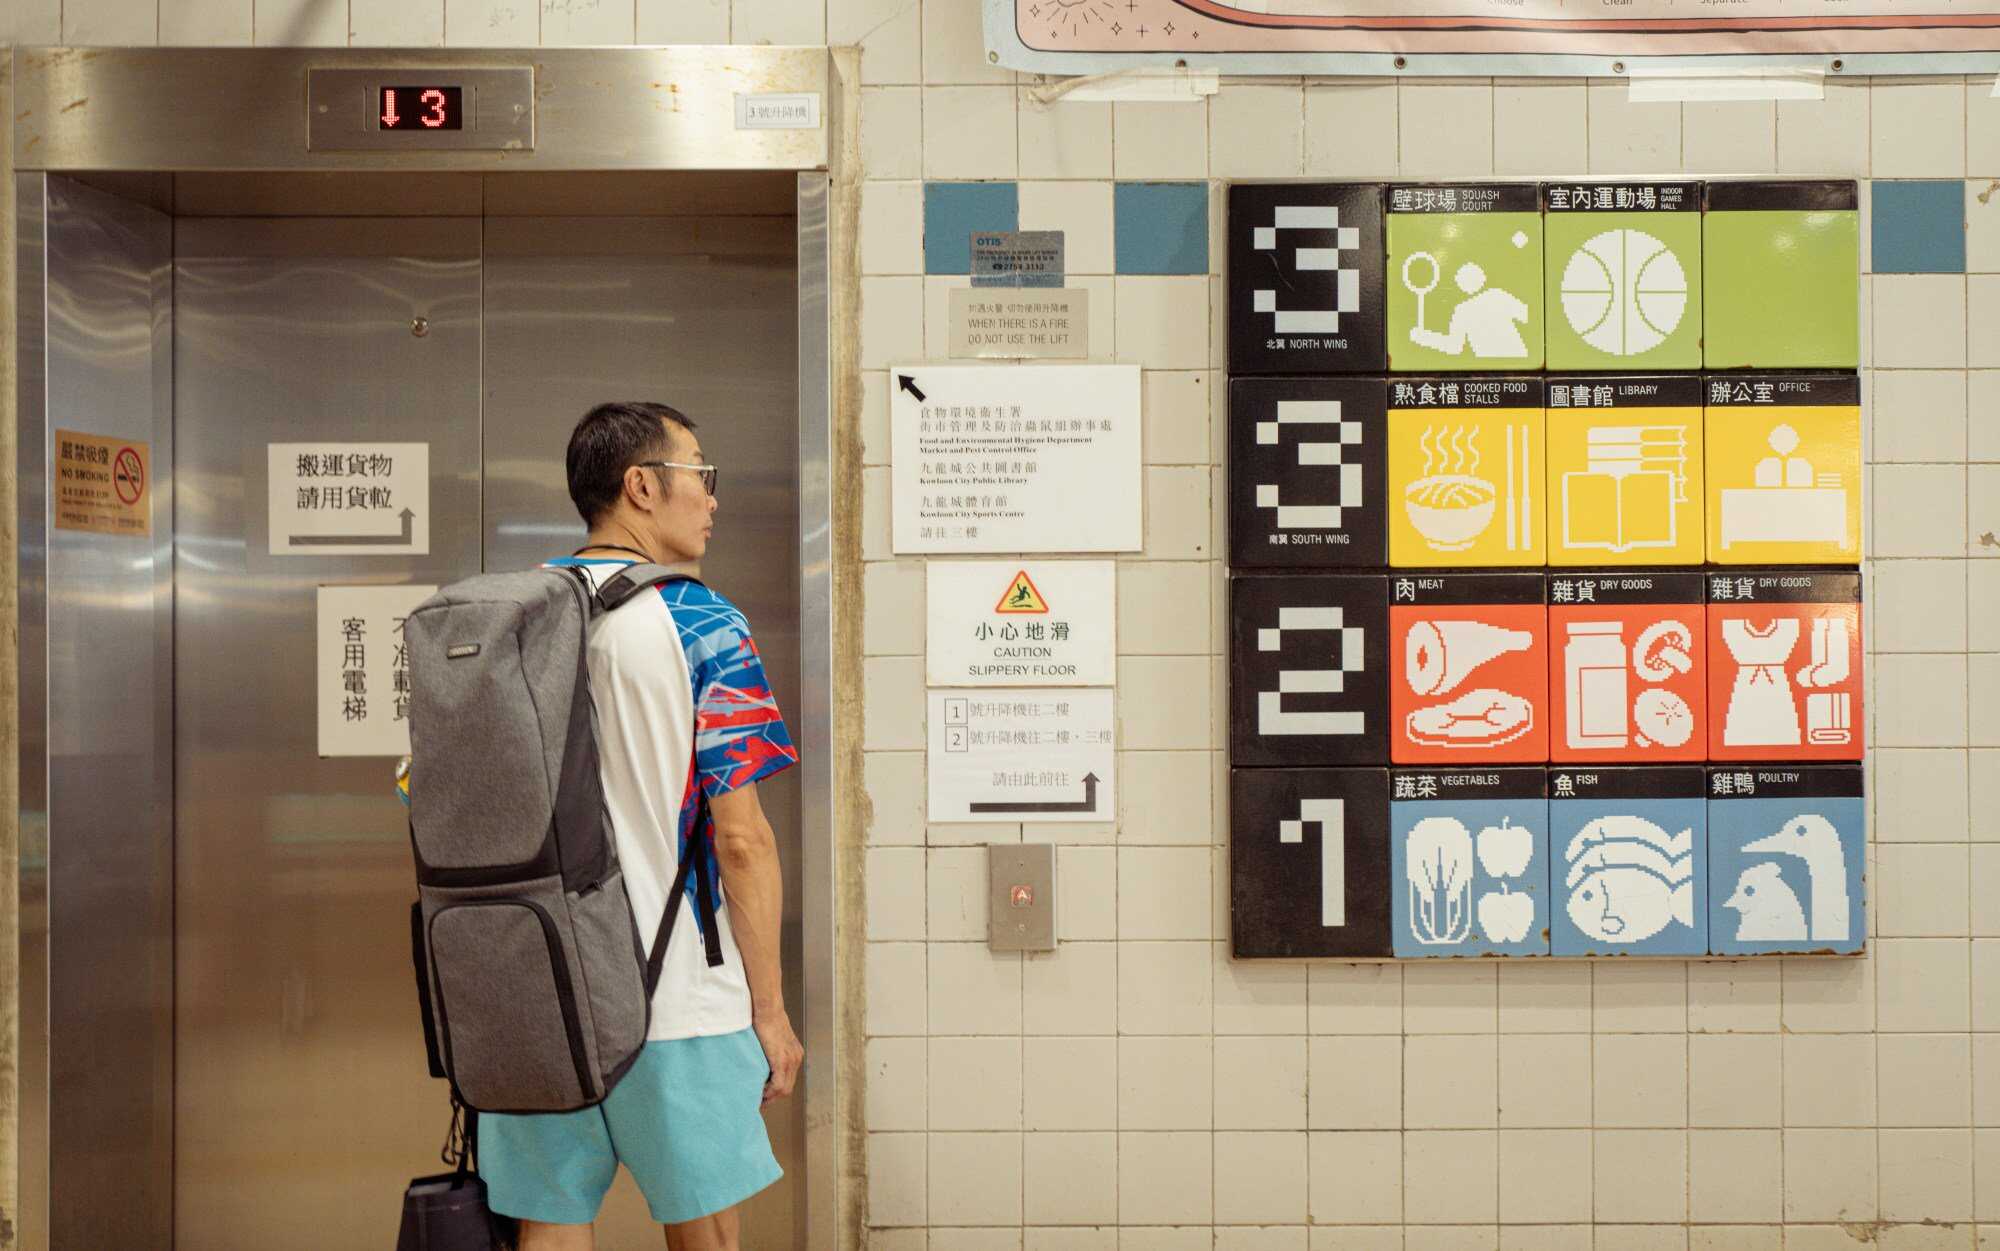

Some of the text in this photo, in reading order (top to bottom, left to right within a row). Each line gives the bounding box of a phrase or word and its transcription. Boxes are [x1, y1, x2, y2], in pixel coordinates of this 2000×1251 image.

[421, 89, 445, 127] 3
[1393, 189, 1457, 211] 壁球場
[1462, 190, 1500, 200] SQUASH
[1462, 201, 1493, 211] COURT
[977, 238, 1001, 246] OTIS
[1254, 206, 1360, 333] 3
[968, 319, 1069, 329] WHEN THERE IS A FIRE
[968, 334, 1069, 345] DO NOT USE THE LIFT
[1289, 339, 1348, 350] NORTH WING
[1464, 383, 1528, 393] COOKED FOOD
[1619, 385, 1658, 395] LIBRARY
[1711, 382, 1774, 403] 辦公室
[1779, 382, 1811, 392] OFFICE
[1394, 382, 1460, 405] 熟食檔
[1464, 394, 1500, 404] STALLS
[1551, 384, 1614, 407] 圖書館
[1014, 437, 1045, 445] Hygiene
[1047, 436, 1092, 445] Department
[296, 453, 392, 477] 搬運貨物
[1256, 400, 1362, 528] 3
[62, 467, 110, 483] NO SMOKING
[954, 477, 971, 485] City
[972, 477, 997, 485] Public
[998, 477, 1028, 485] Library
[955, 511, 971, 519] City
[972, 511, 998, 519] Sports
[999, 511, 1025, 519] Centre
[1292, 534, 1350, 545] SOUTH WING
[1418, 579, 1445, 590] MEAT
[1600, 579, 1653, 590] DRY GOODS
[1760, 577, 1812, 588] DRY GOODS
[1396, 578, 1415, 602] 肉
[1552, 579, 1597, 603] 雜貨
[1711, 577, 1755, 600] 雜貨
[975, 621, 1070, 641] 小心地滑
[993, 647, 1052, 658] CAUTION
[341, 617, 367, 722] 客用電梯
[968, 665, 1077, 676] SLIPPERY FLOOR
[1258, 607, 1364, 735] 2
[992, 771, 1070, 787] 請由此前往
[1441, 774, 1500, 786] VEGETABLES
[1576, 774, 1598, 785] FISH
[1712, 772, 1755, 795] 雞鴨
[1759, 773, 1800, 783] POULTRY
[1394, 775, 1437, 798] 蔬菜
[1554, 774, 1576, 797] 魚
[1280, 798, 1345, 926] 1
